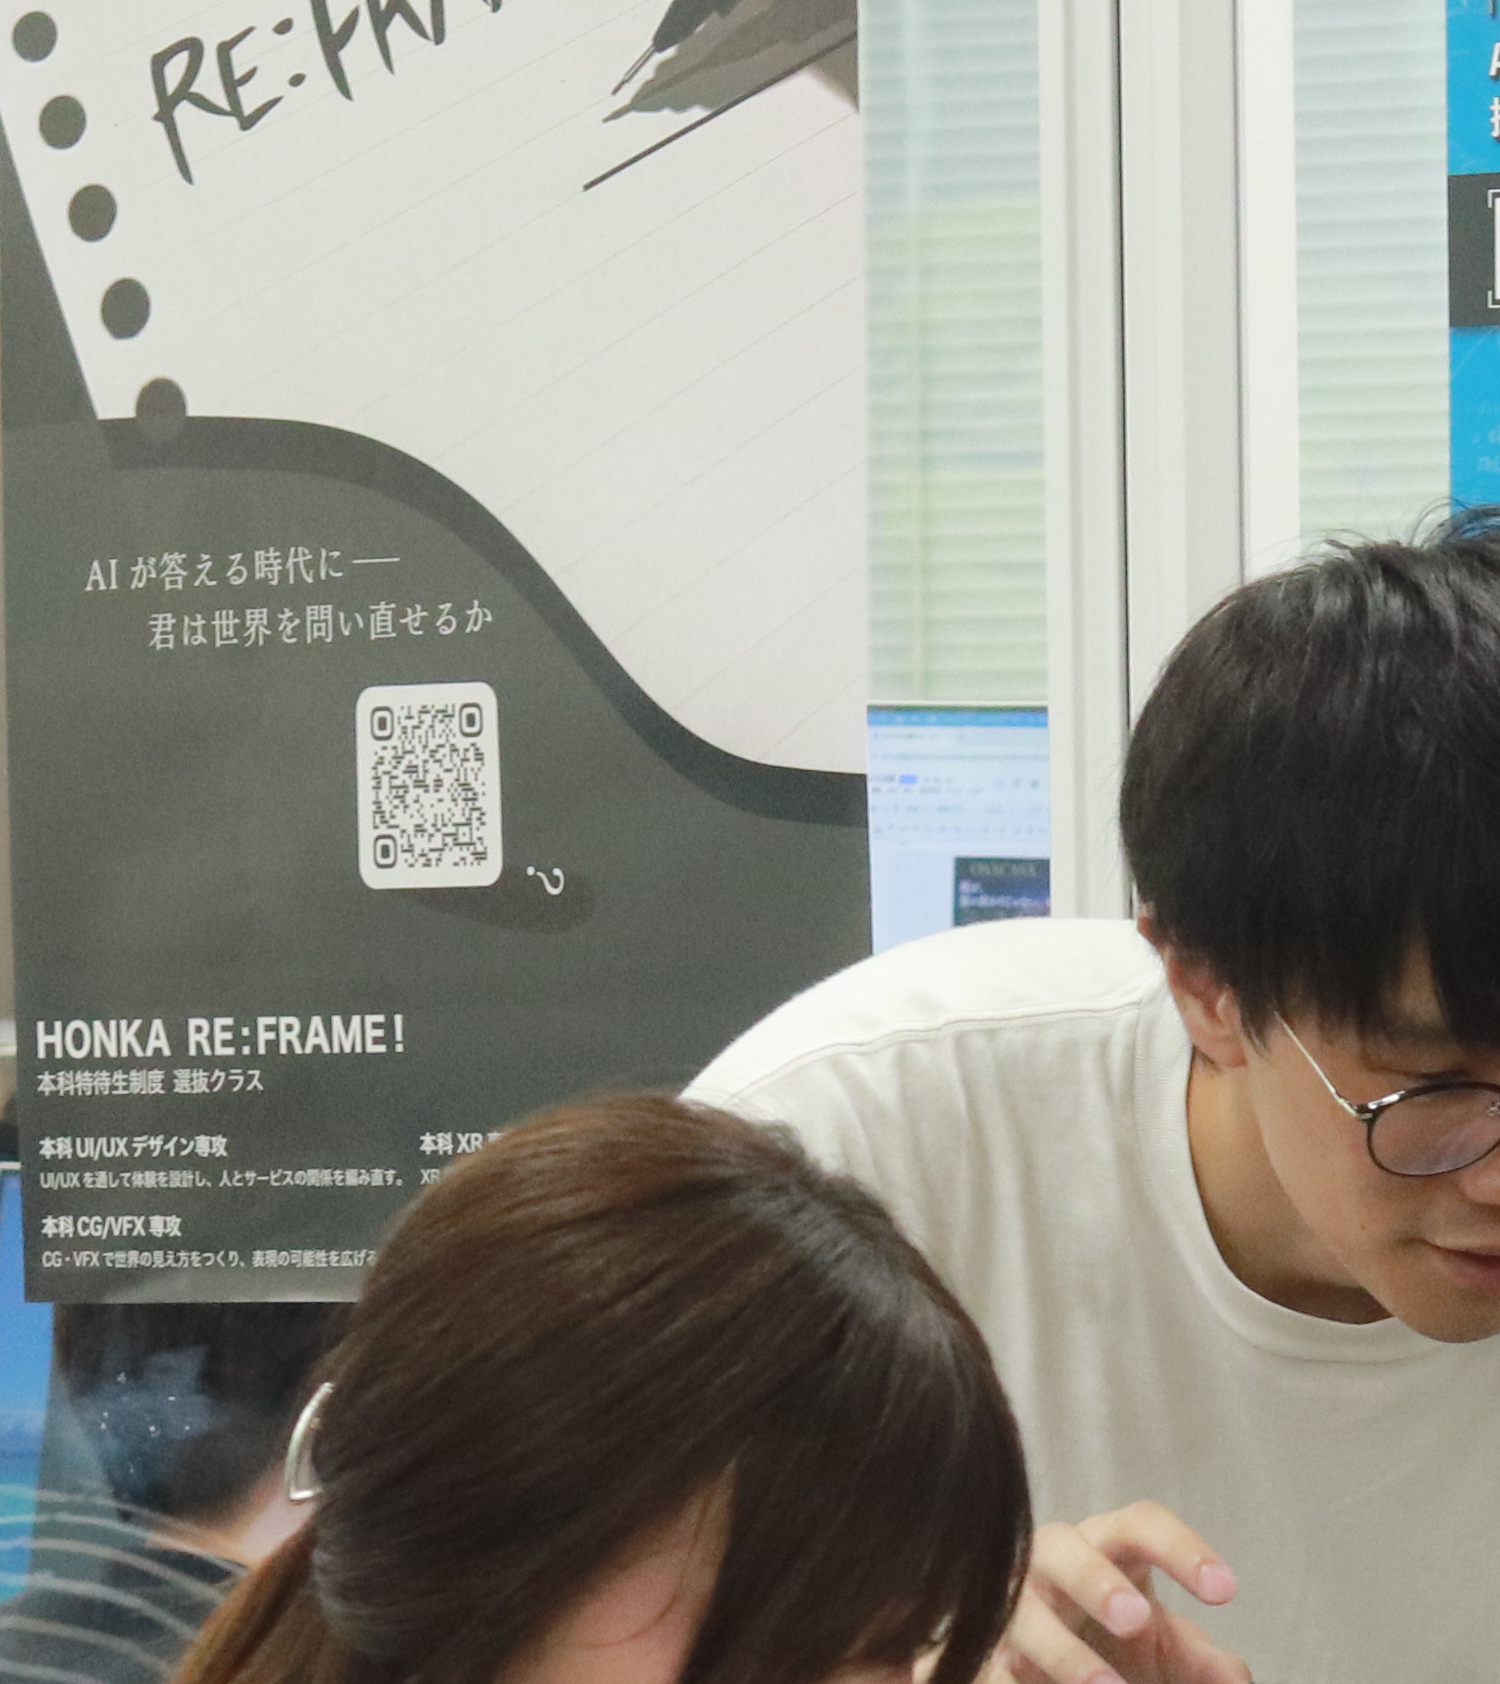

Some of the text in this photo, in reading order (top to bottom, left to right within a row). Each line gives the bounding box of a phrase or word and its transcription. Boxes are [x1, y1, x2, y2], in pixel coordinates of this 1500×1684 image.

[148, 600, 493, 651] 君は世界を問い直せるか
[35, 1012, 405, 1060] HONKA RE:FRAME!
[36, 1067, 264, 1097] 本科特待生制度 選抜クラス
